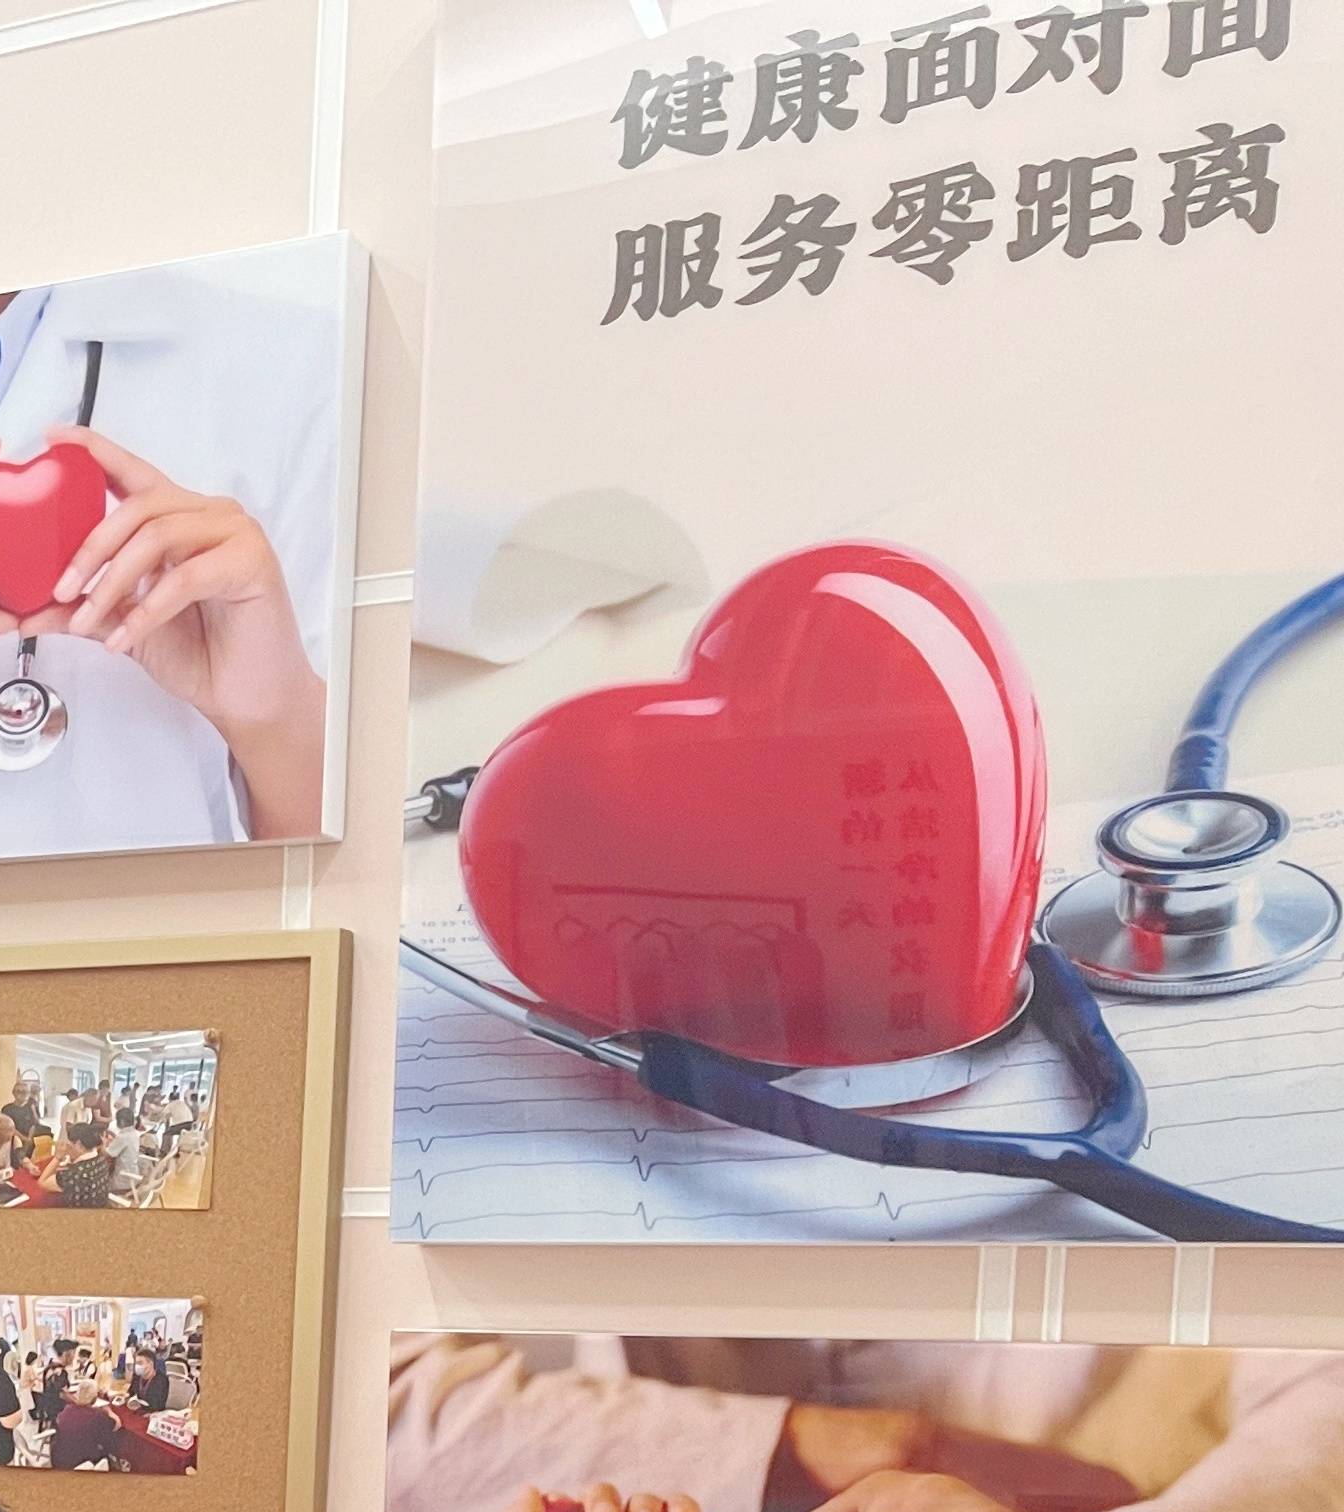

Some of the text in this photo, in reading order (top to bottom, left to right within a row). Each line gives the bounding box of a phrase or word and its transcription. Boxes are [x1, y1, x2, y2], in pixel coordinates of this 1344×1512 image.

[611, 0, 1293, 170] 健康面对面
[600, 122, 1288, 326] 服务零距离
